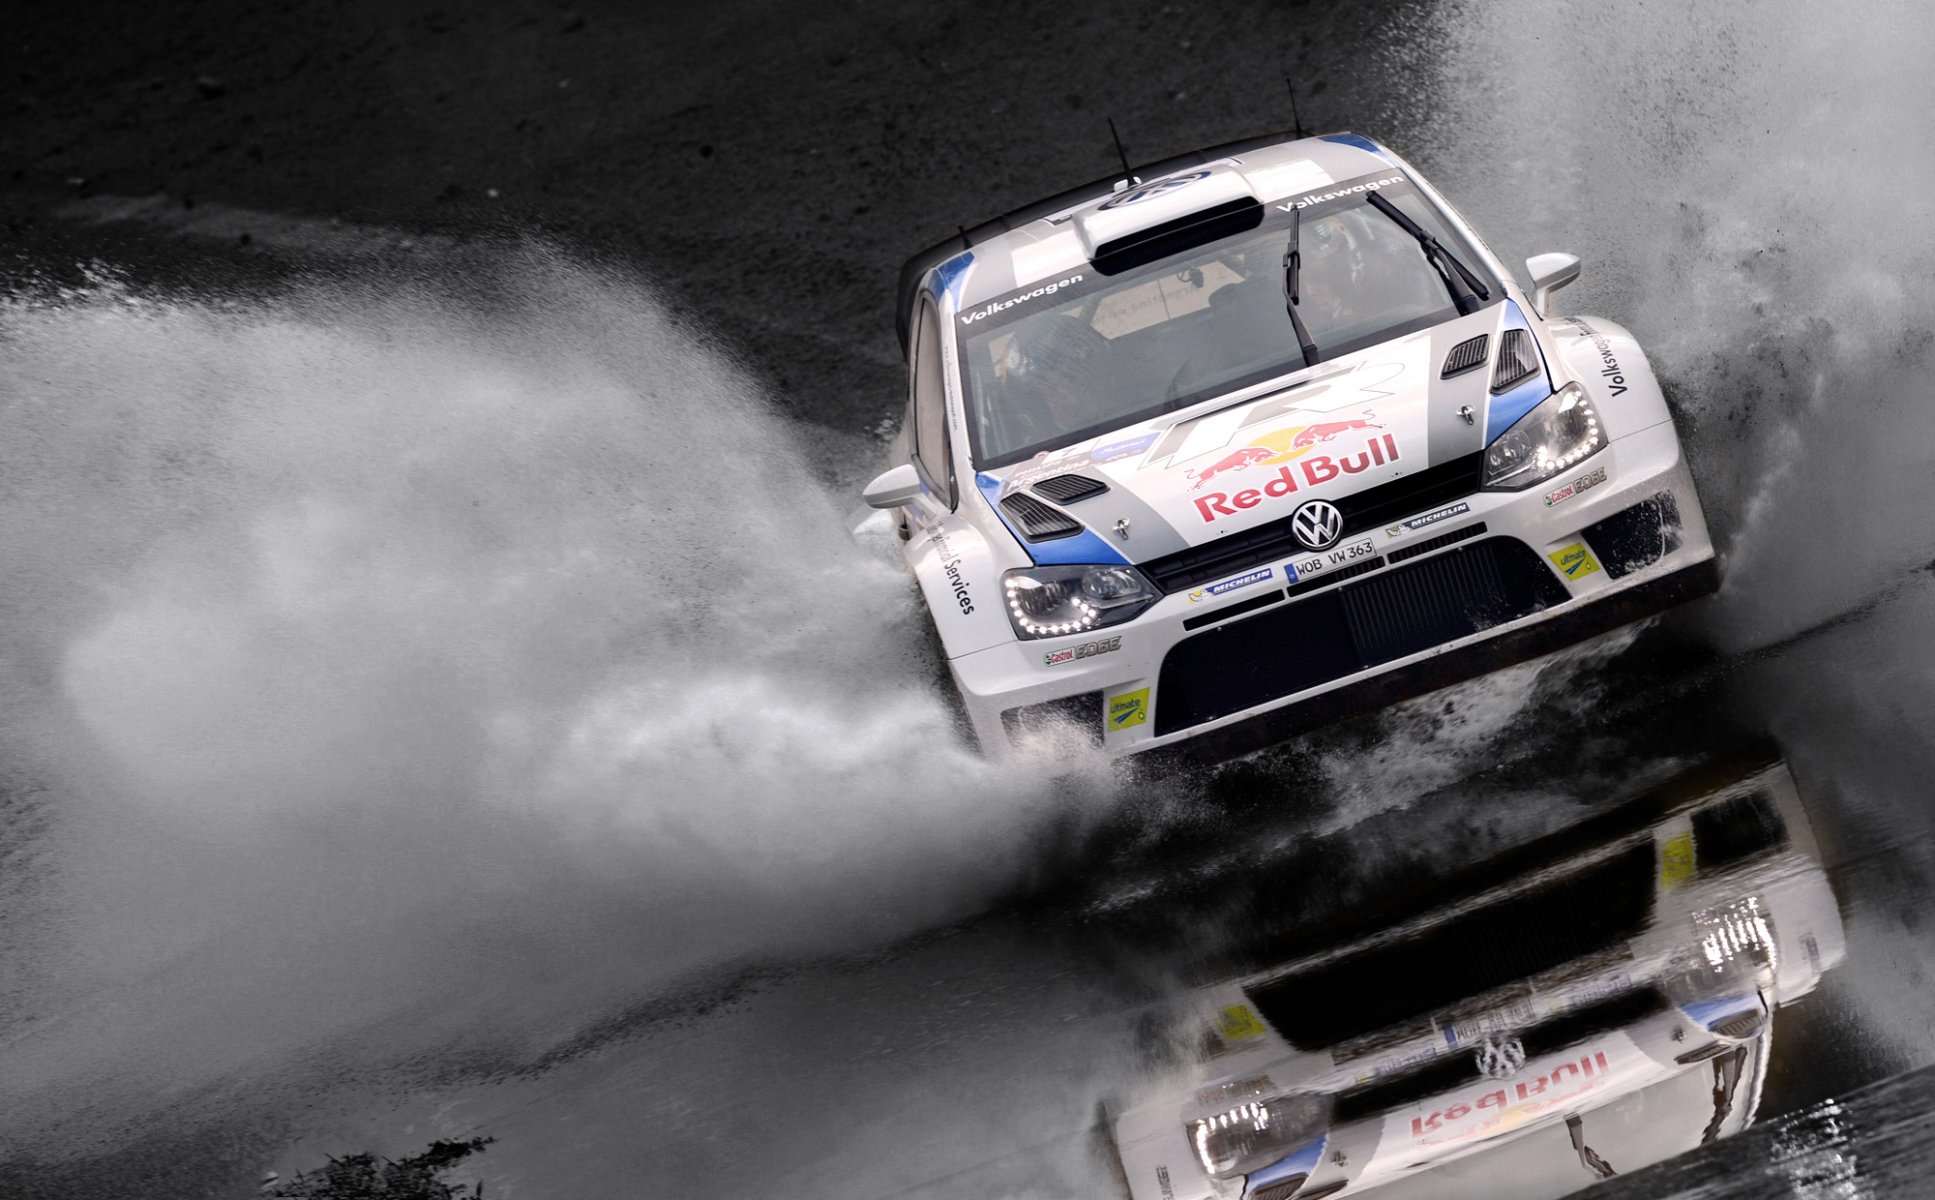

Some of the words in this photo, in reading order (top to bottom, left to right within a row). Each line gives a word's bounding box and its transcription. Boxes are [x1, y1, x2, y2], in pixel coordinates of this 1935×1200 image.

[1276, 175, 1404, 213] Volkswagen
[960, 274, 1084, 325] Volkswagen
[1194, 466, 1299, 523] Red
[1300, 433, 1401, 488] Bull
[1410, 502, 1467, 527] MICHELIN
[1296, 558, 1323, 576] WOB
[1328, 550, 1346, 565] VW
[1347, 541, 1373, 559] 363
[943, 559, 975, 615] Services
[1213, 569, 1270, 594] MICHELIN
[1075, 635, 1123, 660] EDGE
